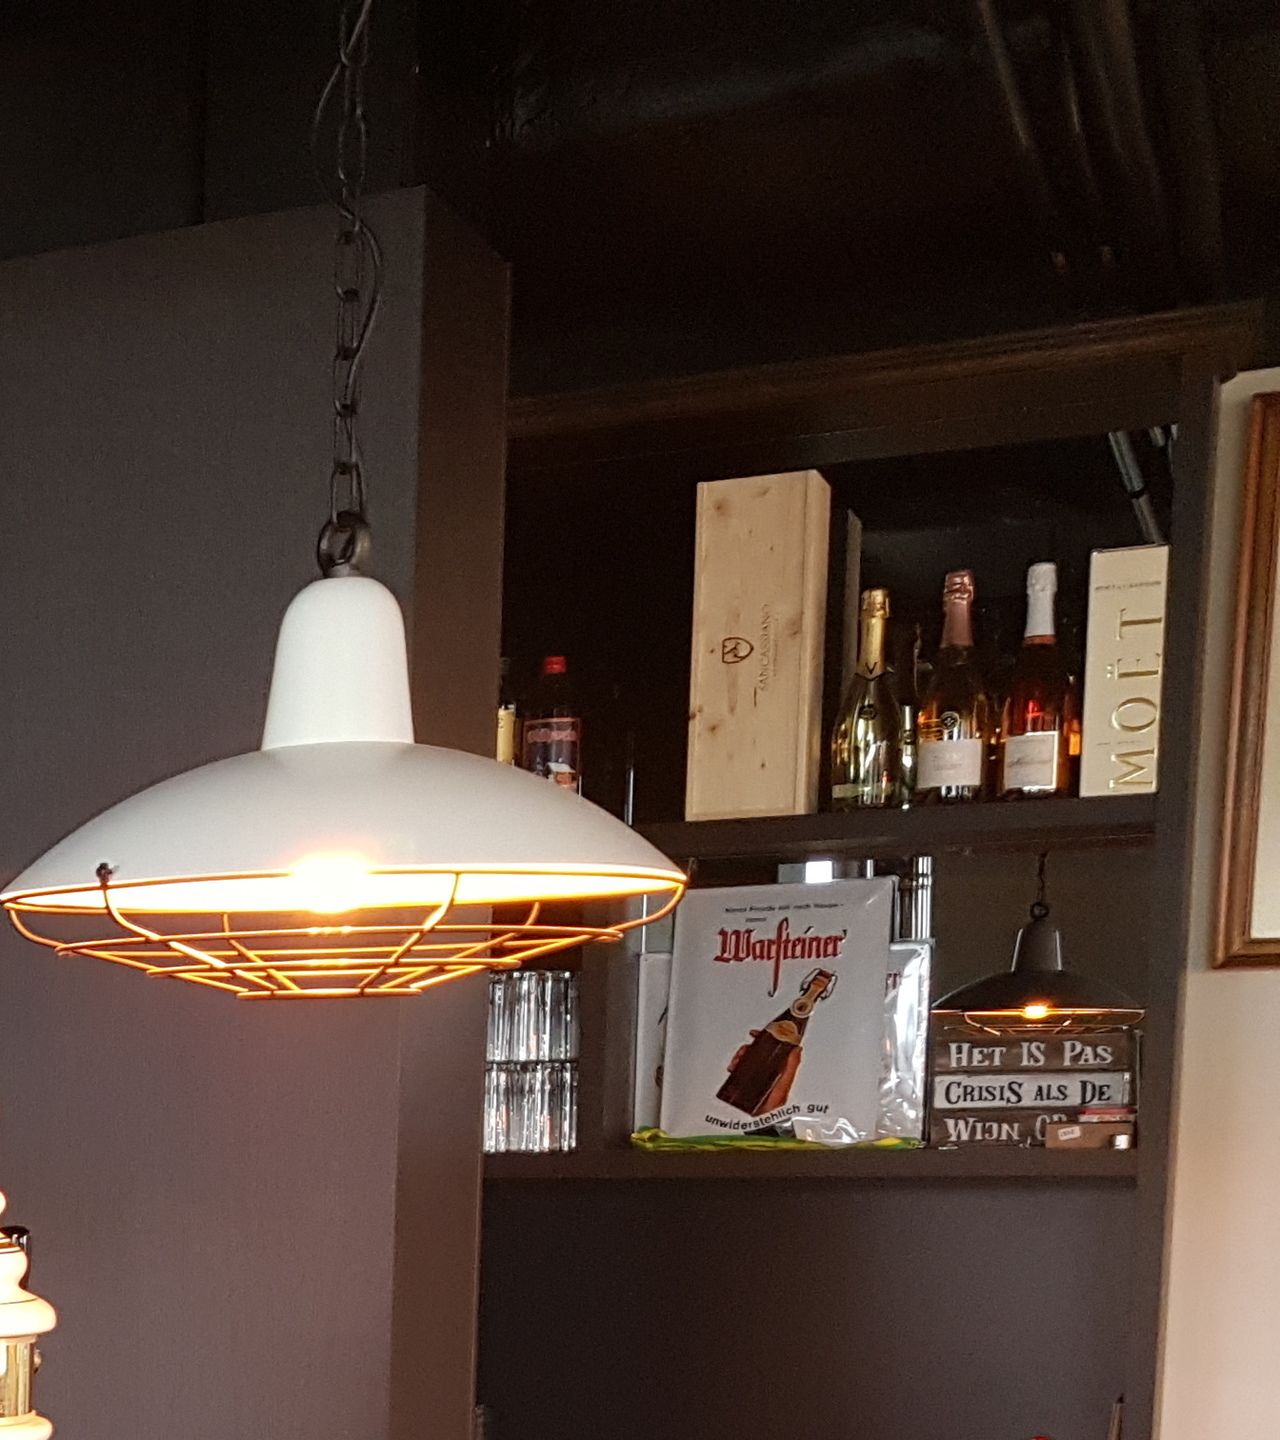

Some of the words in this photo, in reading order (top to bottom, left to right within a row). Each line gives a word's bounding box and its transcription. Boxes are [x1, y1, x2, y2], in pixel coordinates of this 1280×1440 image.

[948, 1041, 1007, 1068] HET
[1020, 1041, 1046, 1067] IS
[1063, 1040, 1114, 1066] PAS
[1033, 1084, 1068, 1102] ALS
[1079, 1080, 1111, 1105] DE
[705, 1103, 801, 1131] unwiderstehlich
[807, 1103, 830, 1115] gut
